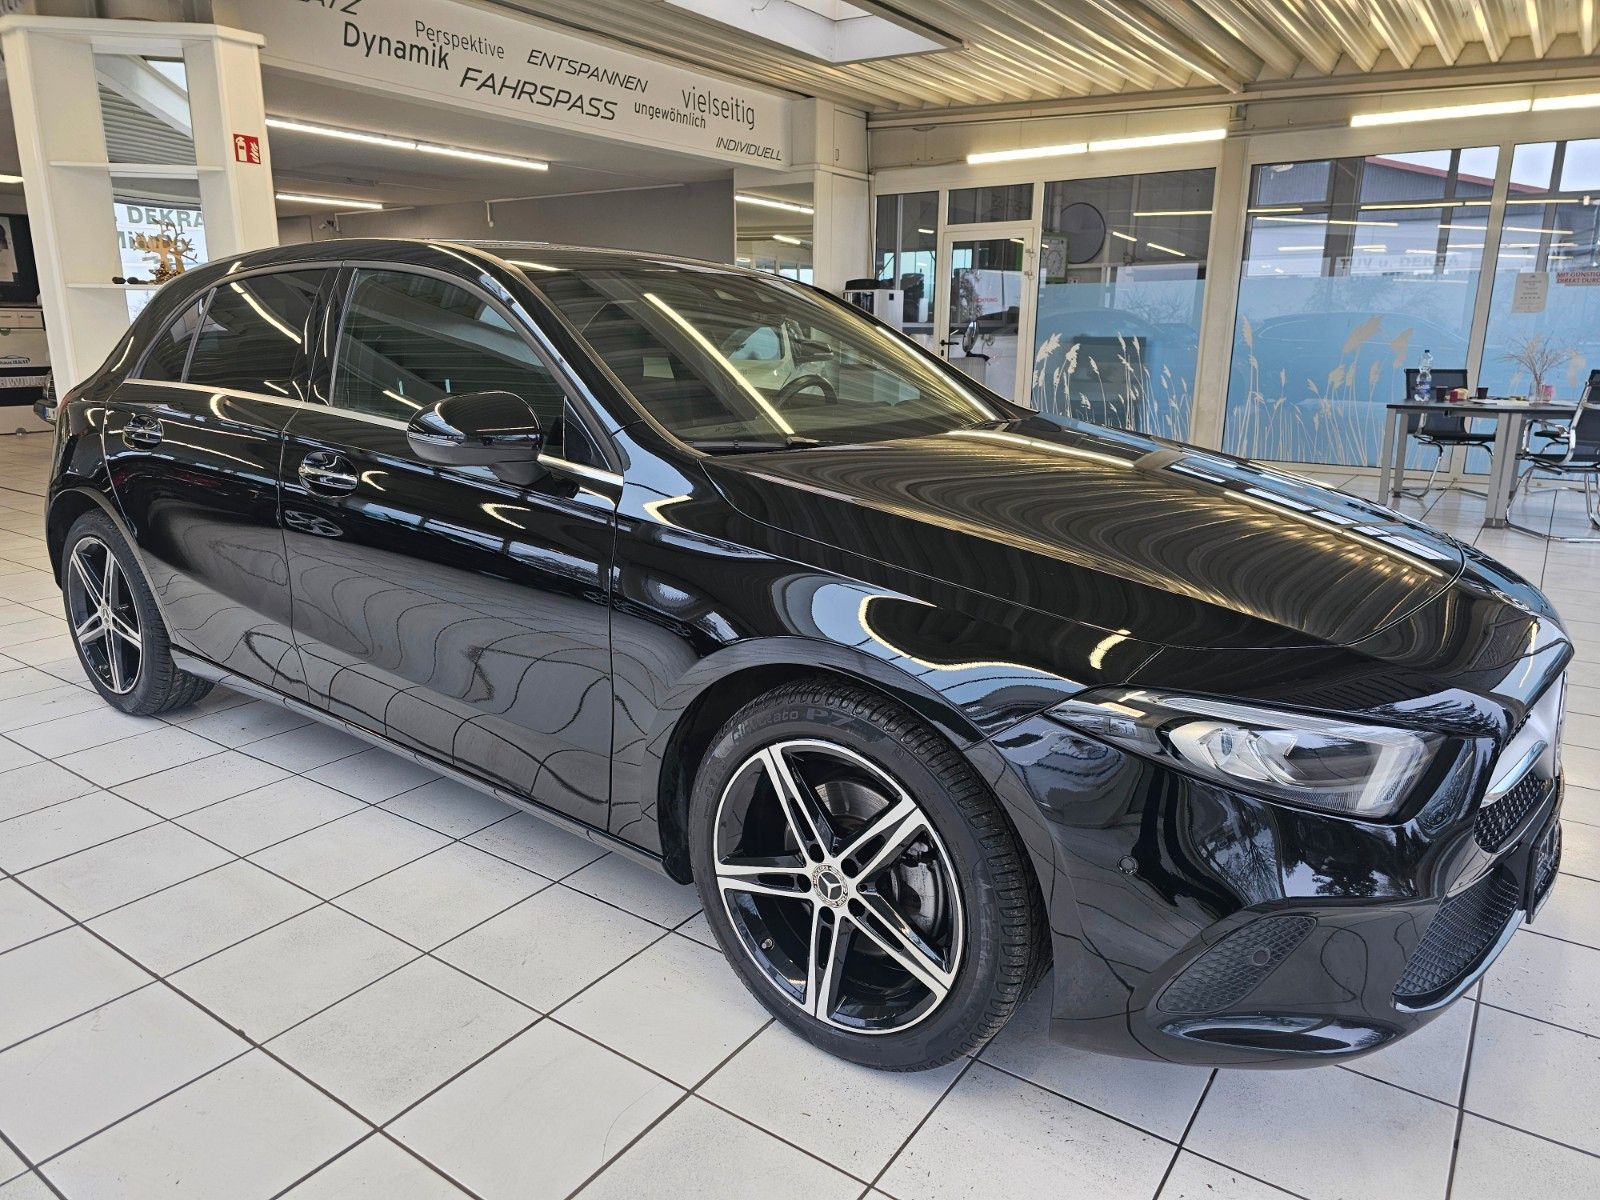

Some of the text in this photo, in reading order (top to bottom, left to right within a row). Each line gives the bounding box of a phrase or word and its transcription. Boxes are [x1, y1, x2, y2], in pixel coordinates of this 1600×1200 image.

[343, 21, 449, 70] Dynamik
[415, 20, 505, 59] Perspektive
[527, 49, 649, 93] ENTSPANNEN
[459, 66, 618, 121] FAHRSPASS
[681, 86, 755, 130] vielseitig
[634, 101, 706, 129] ungewöhnlich
[716, 136, 782, 161] INDIVIDUELL
[127, 205, 204, 227] DEKRA
